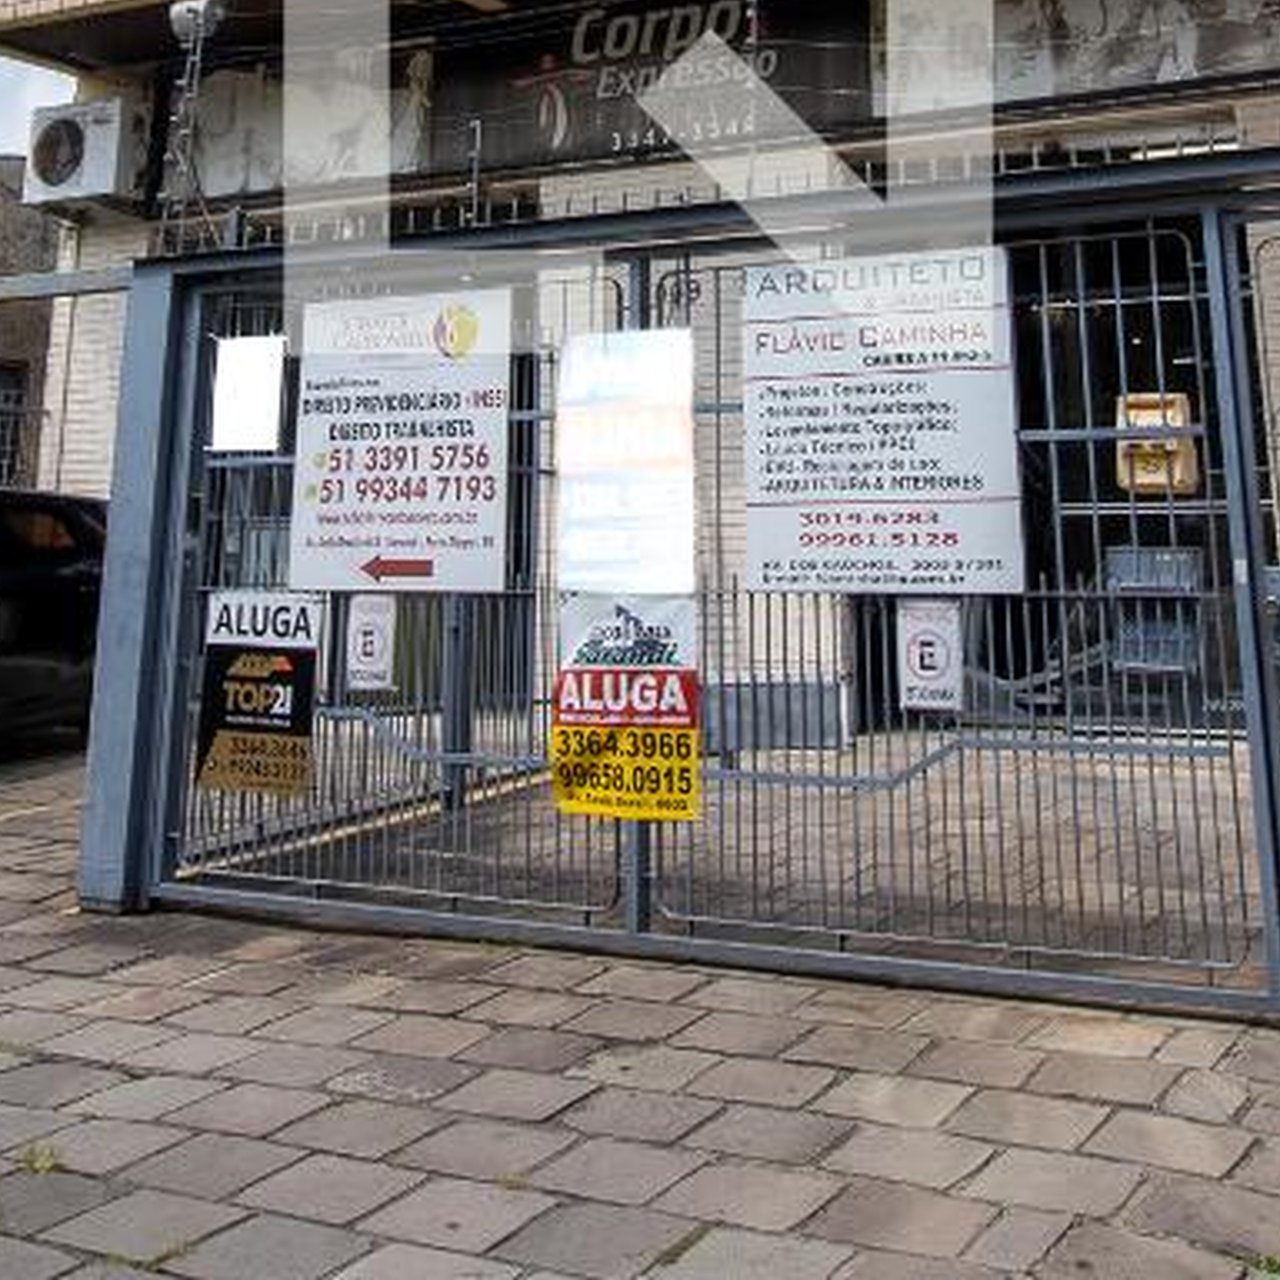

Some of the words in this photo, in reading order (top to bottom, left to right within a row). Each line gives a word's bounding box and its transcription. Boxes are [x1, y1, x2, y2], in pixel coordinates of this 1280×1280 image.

[572, 0, 741, 64] Corpo
[756, 256, 985, 298] ARQUITETO
[858, 322, 988, 349] CAMINHA
[327, 448, 355, 471] 51
[363, 446, 419, 471] 3391
[429, 444, 491, 470] 5756
[319, 480, 345, 504] 51
[355, 477, 429, 503] 99344
[436, 475, 497, 501] 7193
[213, 603, 312, 639] ALUGA
[919, 640, 937, 671] E
[559, 673, 688, 712] ALUGA
[557, 730, 692, 760] 3364.3966
